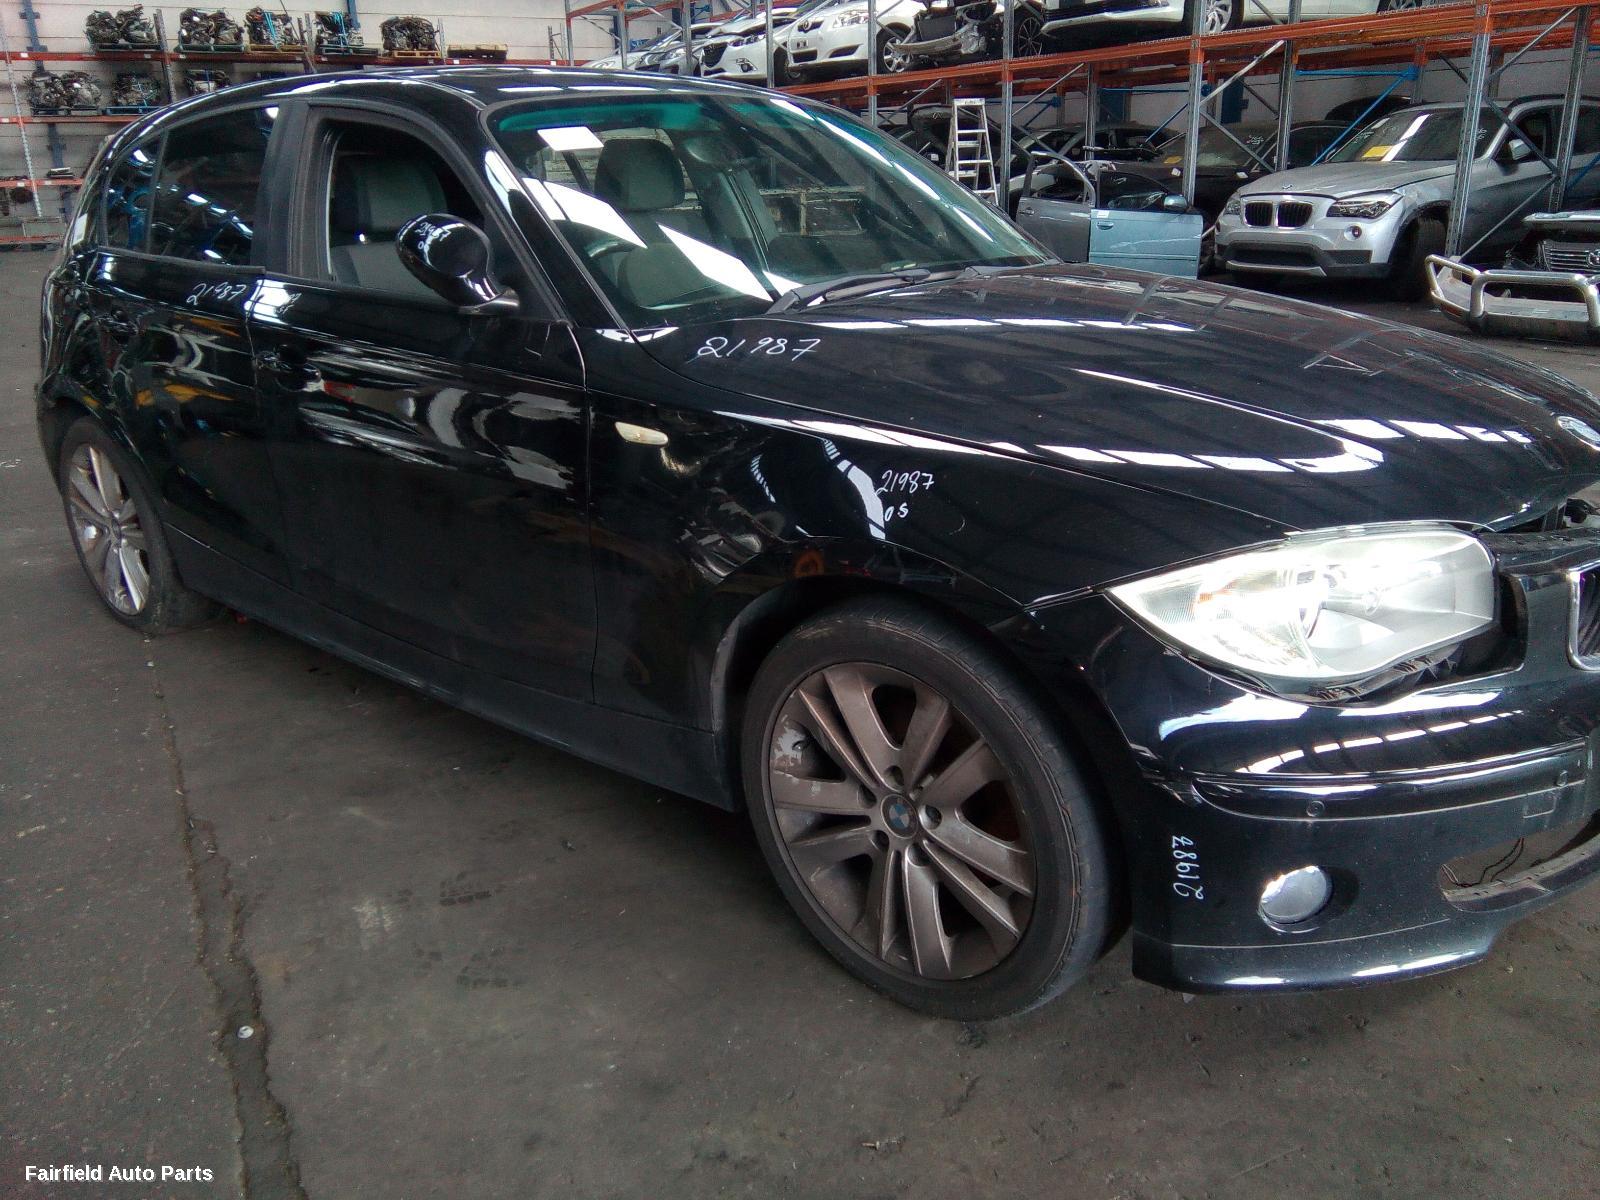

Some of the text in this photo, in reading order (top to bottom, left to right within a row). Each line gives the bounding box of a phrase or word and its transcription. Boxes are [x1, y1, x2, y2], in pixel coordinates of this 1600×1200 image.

[186, 281, 247, 305] 21987
[692, 336, 821, 361] 21987
[875, 469, 935, 494] 21987
[1172, 835, 1204, 900] 21987
